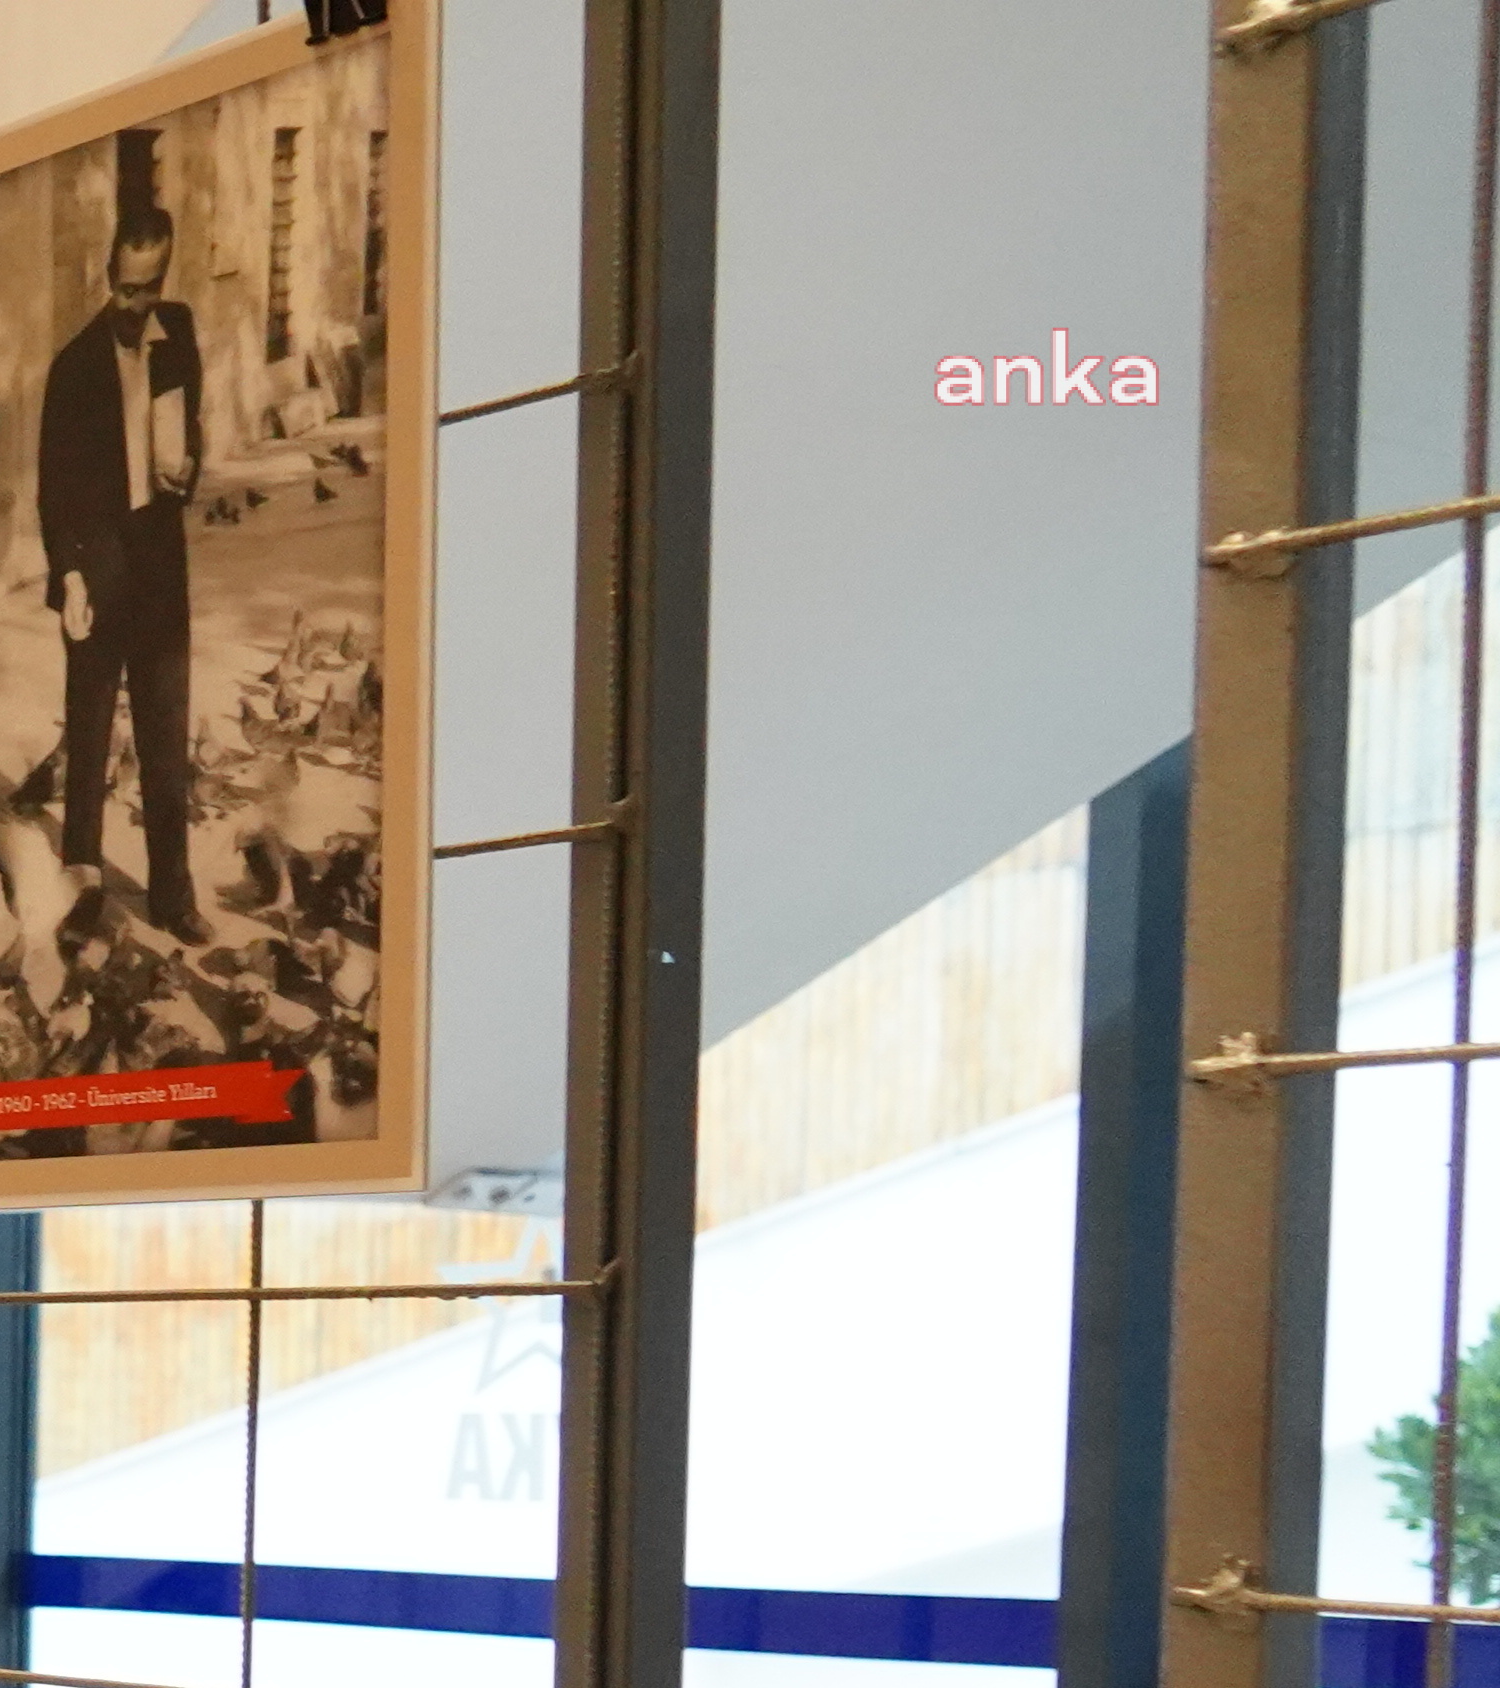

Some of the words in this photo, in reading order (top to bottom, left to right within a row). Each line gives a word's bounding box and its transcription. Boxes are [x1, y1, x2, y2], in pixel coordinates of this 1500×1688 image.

[43, 1092, 77, 1111] 1962
[87, 1086, 166, 1107] Üniversite
[168, 1082, 218, 1101] Yılları
